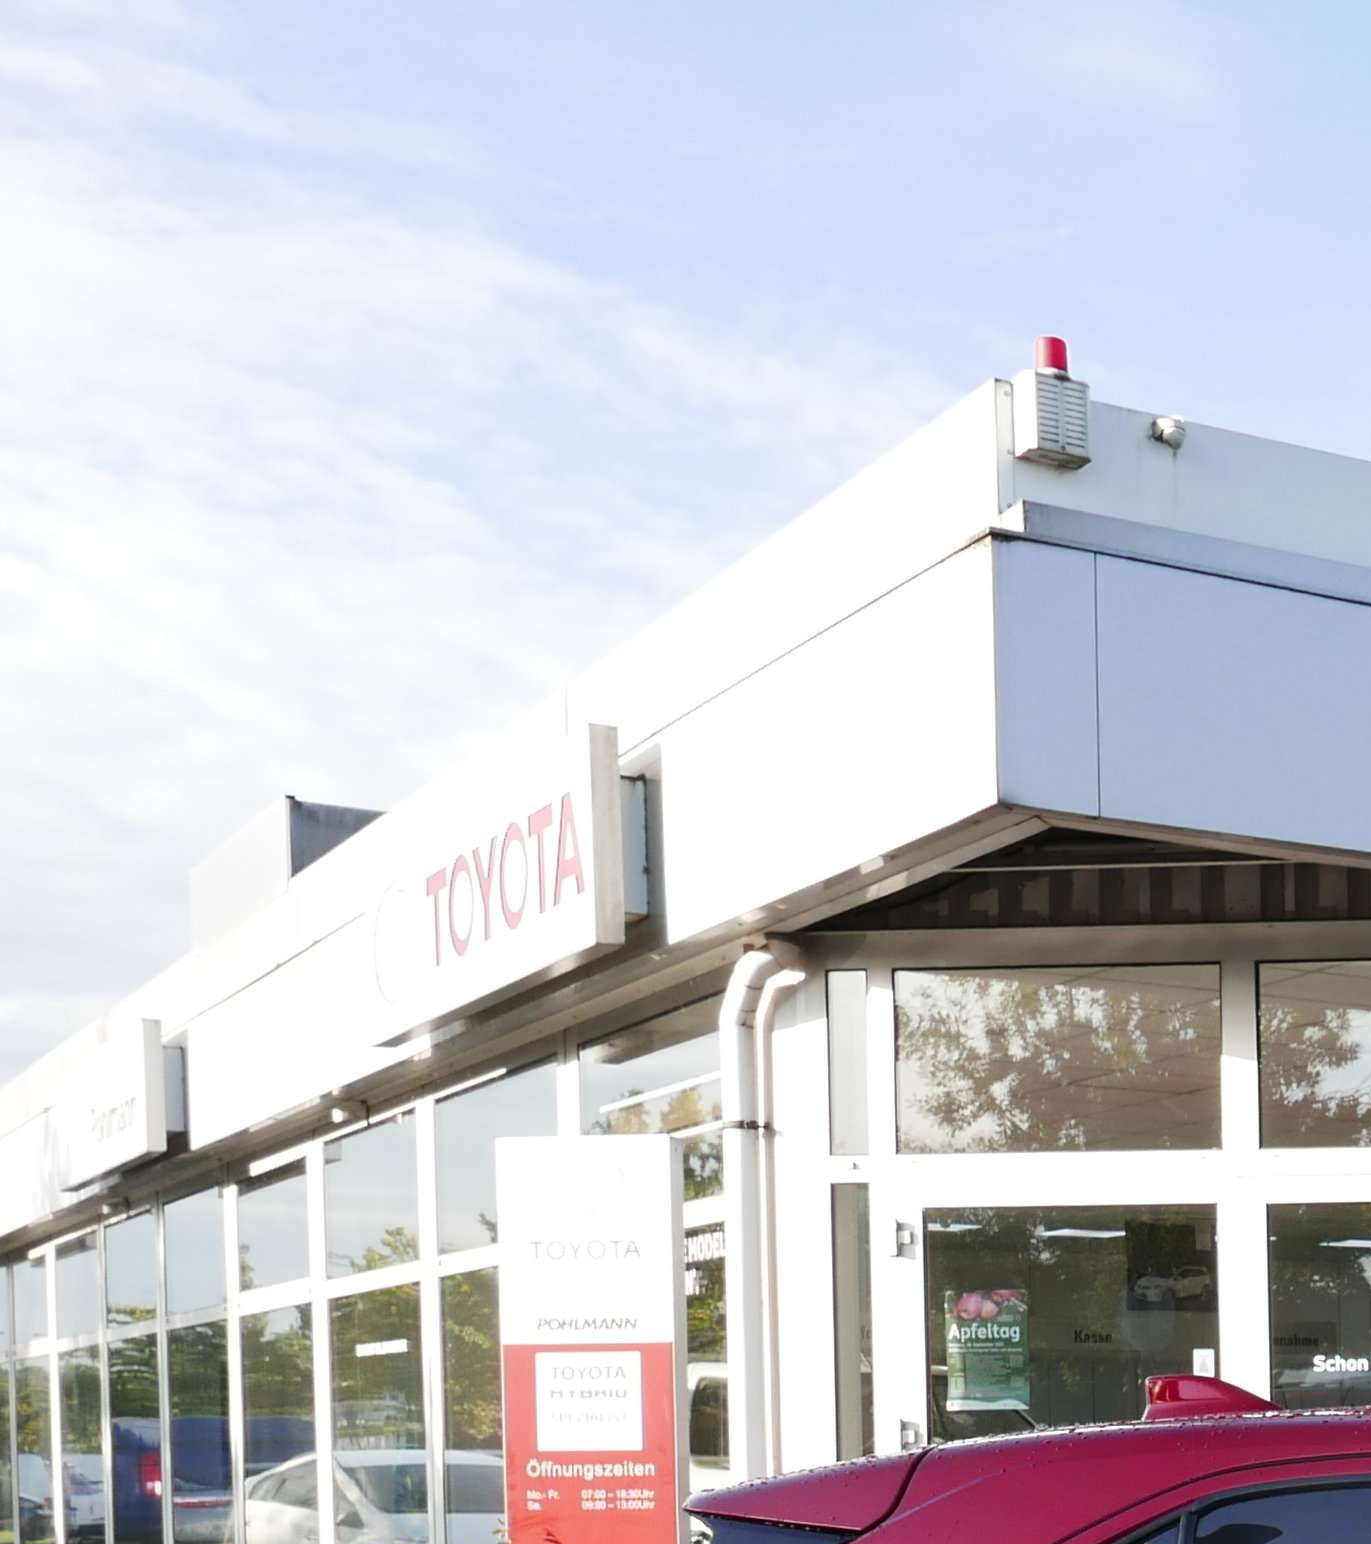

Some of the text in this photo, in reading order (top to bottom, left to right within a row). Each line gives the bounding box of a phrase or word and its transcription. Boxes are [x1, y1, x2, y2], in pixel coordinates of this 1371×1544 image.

[426, 791, 586, 967] TOYOTA
[530, 1239, 642, 1261] TOYOTA
[537, 1317, 638, 1331] POHLMANN
[948, 1323, 1020, 1343] Apfeltag
[551, 1366, 627, 1381] TOYOTA
[1313, 1355, 1369, 1373] Schon
[526, 1458, 656, 1481] Öffnungszeiten
